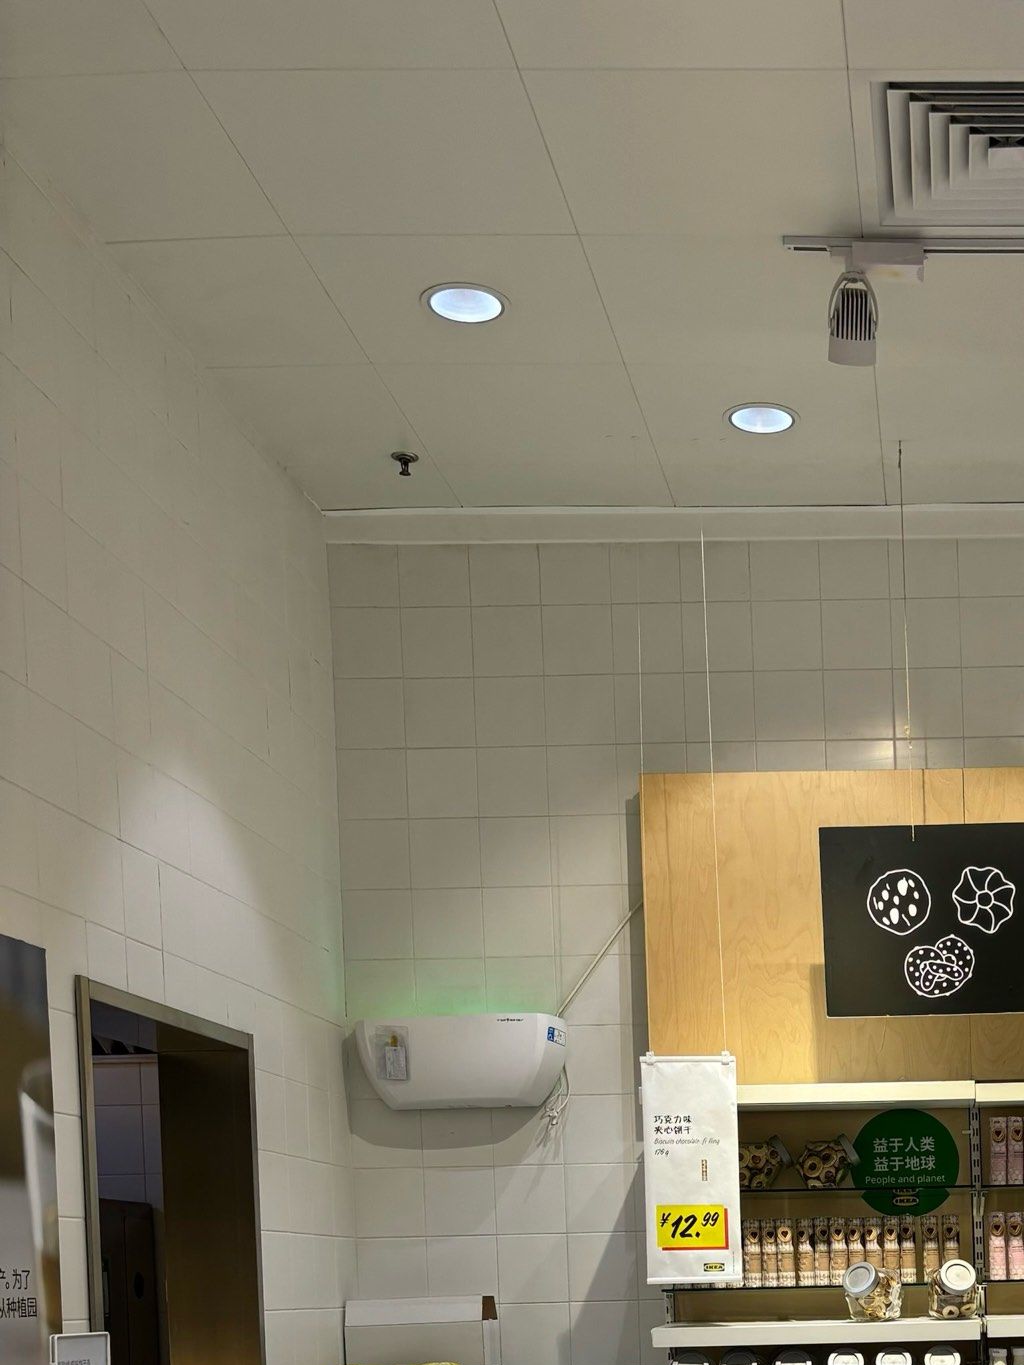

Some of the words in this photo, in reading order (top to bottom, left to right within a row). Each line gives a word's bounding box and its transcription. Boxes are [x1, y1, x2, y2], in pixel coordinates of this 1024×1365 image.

[654, 1115, 692, 1124] 巧克力味
[654, 1126, 692, 1135] 夹心饼干
[873, 1137, 936, 1153] 益于人类
[873, 1155, 936, 1172] 益于地球
[865, 1175, 895, 1186] People
[898, 1174, 914, 1184] and
[916, 1173, 946, 1185] planet
